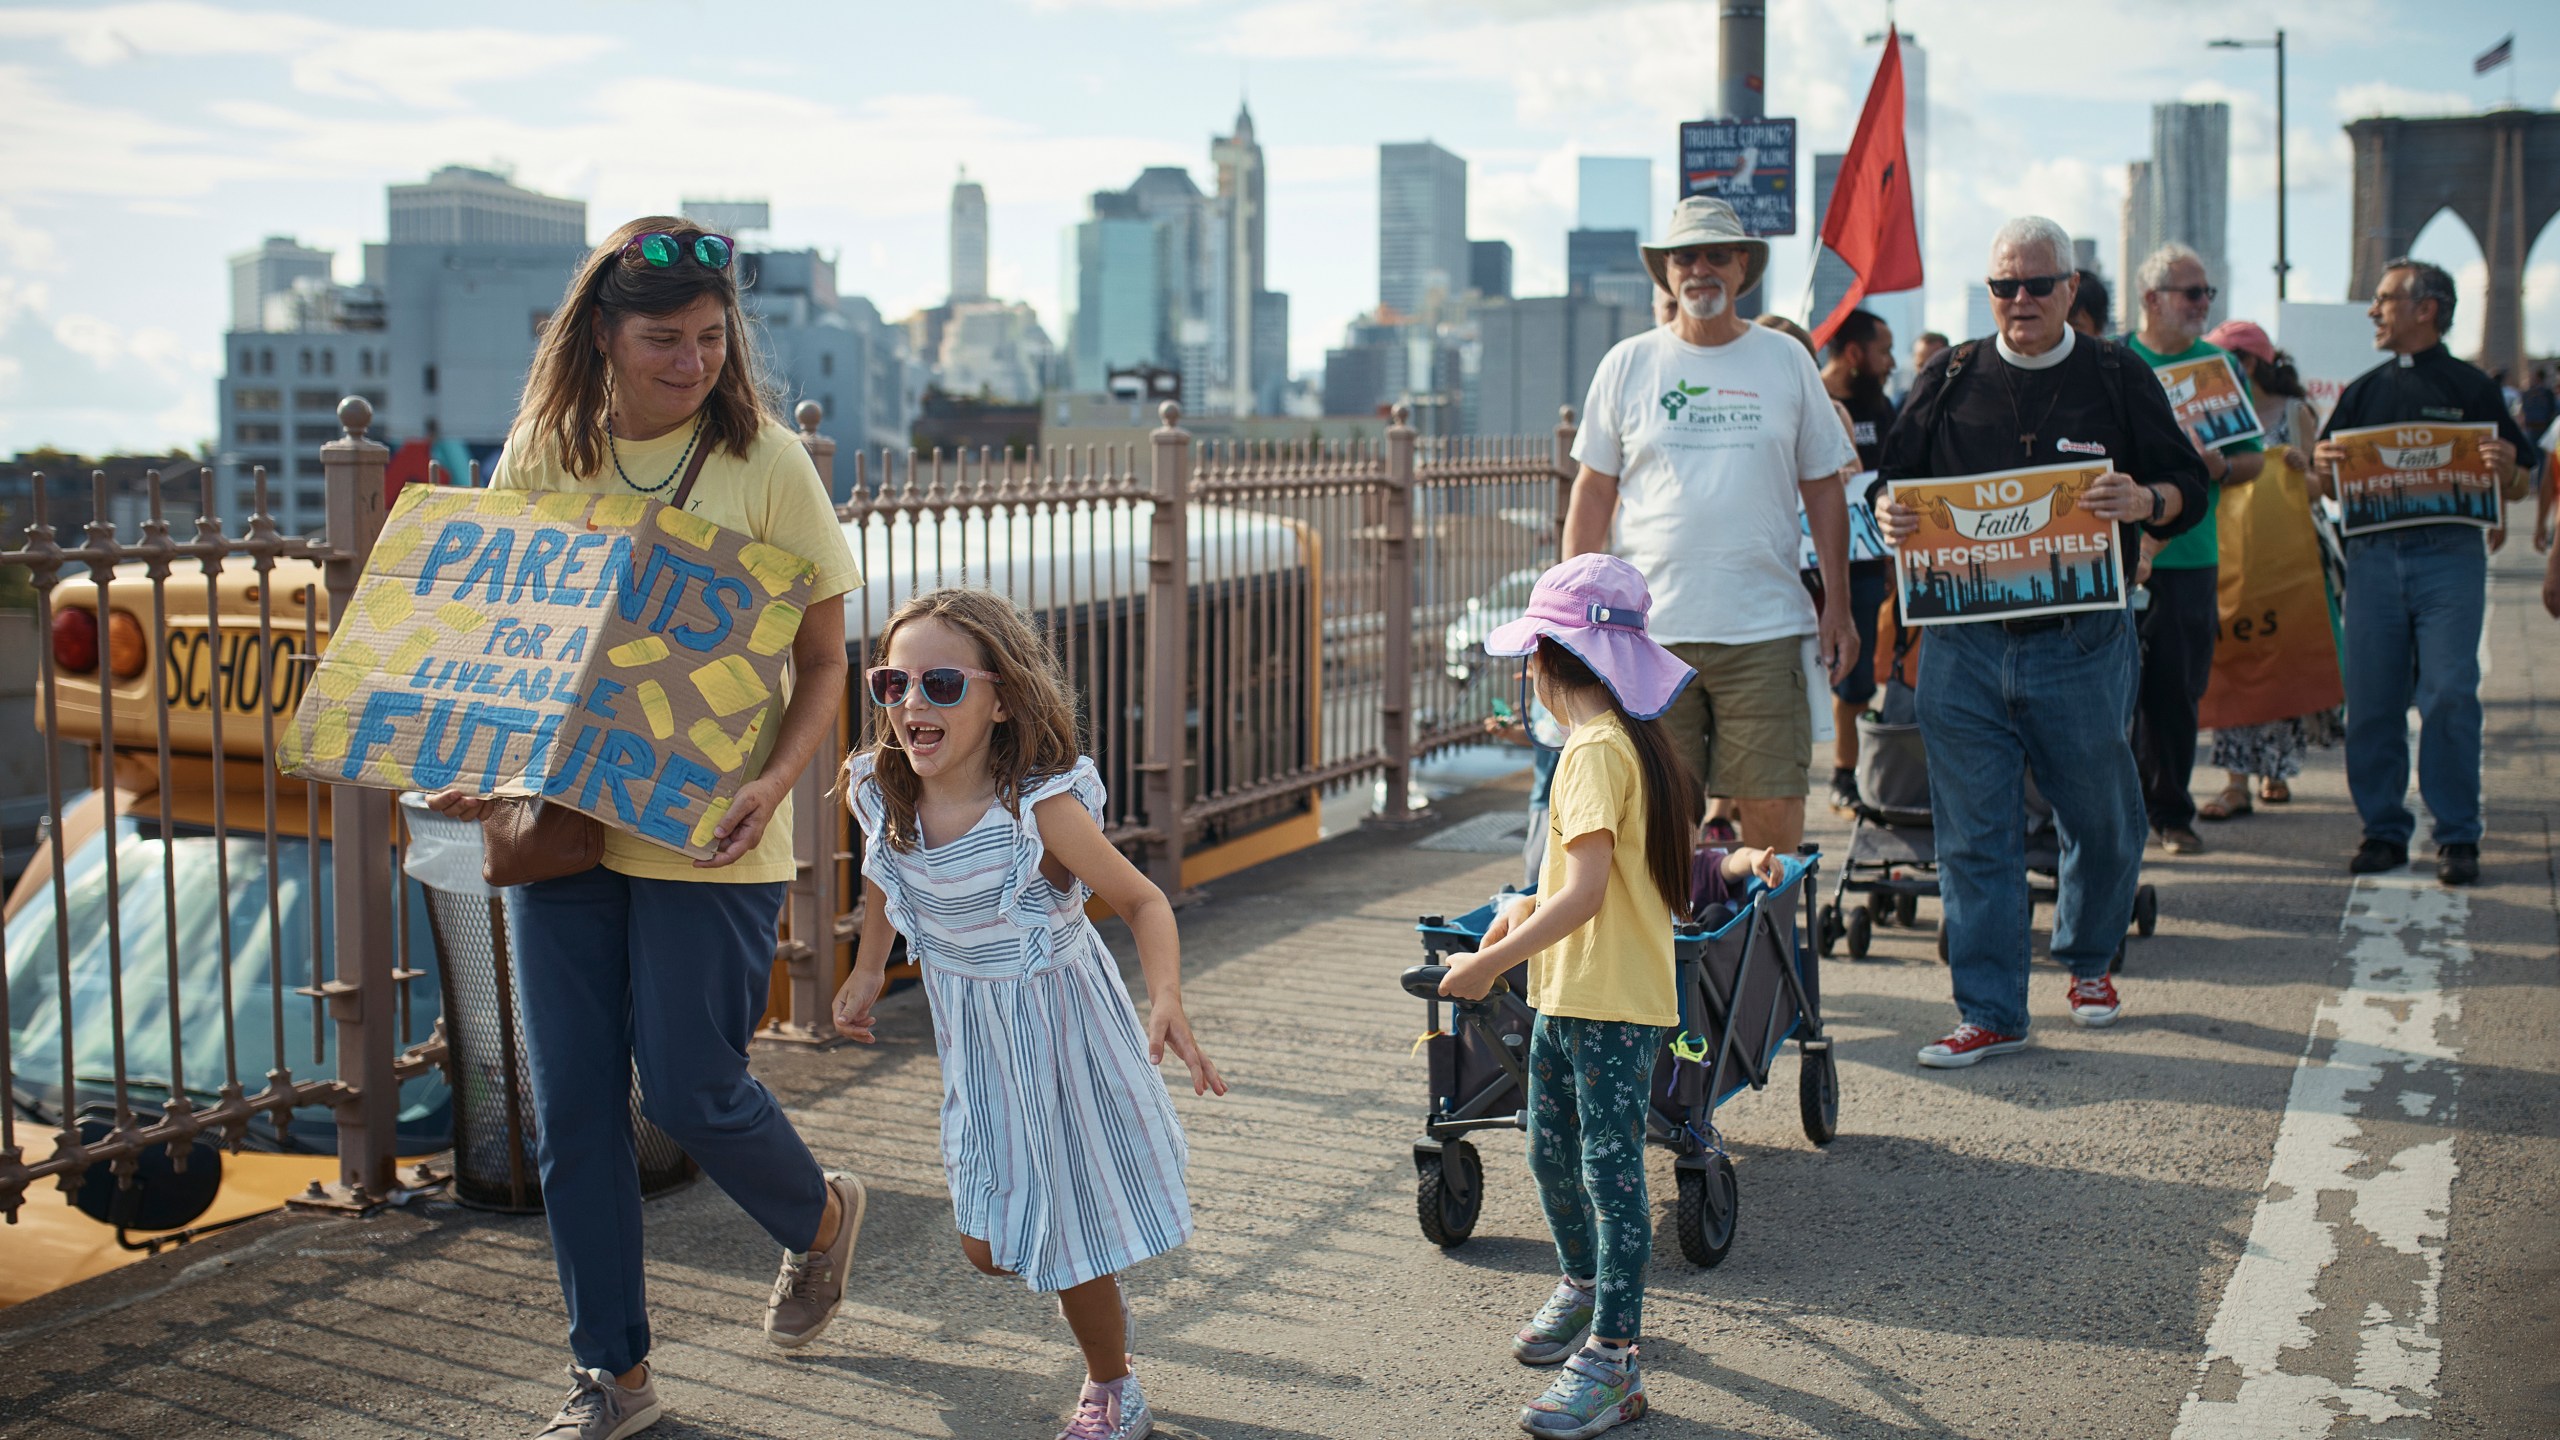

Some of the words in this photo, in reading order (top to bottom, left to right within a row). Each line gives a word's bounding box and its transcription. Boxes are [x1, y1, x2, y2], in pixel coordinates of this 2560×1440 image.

[1684, 127, 1737, 148] TROUBLE
[1738, 124, 1792, 146] COPING?
[1688, 412, 1726, 424] Earth
[1730, 411, 1763, 423] Care
[2187, 391, 2240, 416] FUELS
[2395, 429, 2433, 446] NO
[2396, 447, 2440, 467] Faith
[1974, 479, 2024, 507] NO
[2343, 479, 2363, 495] IN
[2367, 471, 2433, 492] FOSSIL
[2438, 470, 2491, 488] FUELS
[1974, 506, 2033, 538] Faith
[1905, 549, 1931, 568] IN
[1937, 541, 2023, 567] FOSSIL
[2028, 531, 2109, 557] FUELS
[414, 521, 753, 653] PARENTS
[483, 617, 554, 660] FOR
[555, 626, 589, 663] A
[408, 656, 627, 721] LIVEABLE
[341, 691, 721, 849] FUTURE
